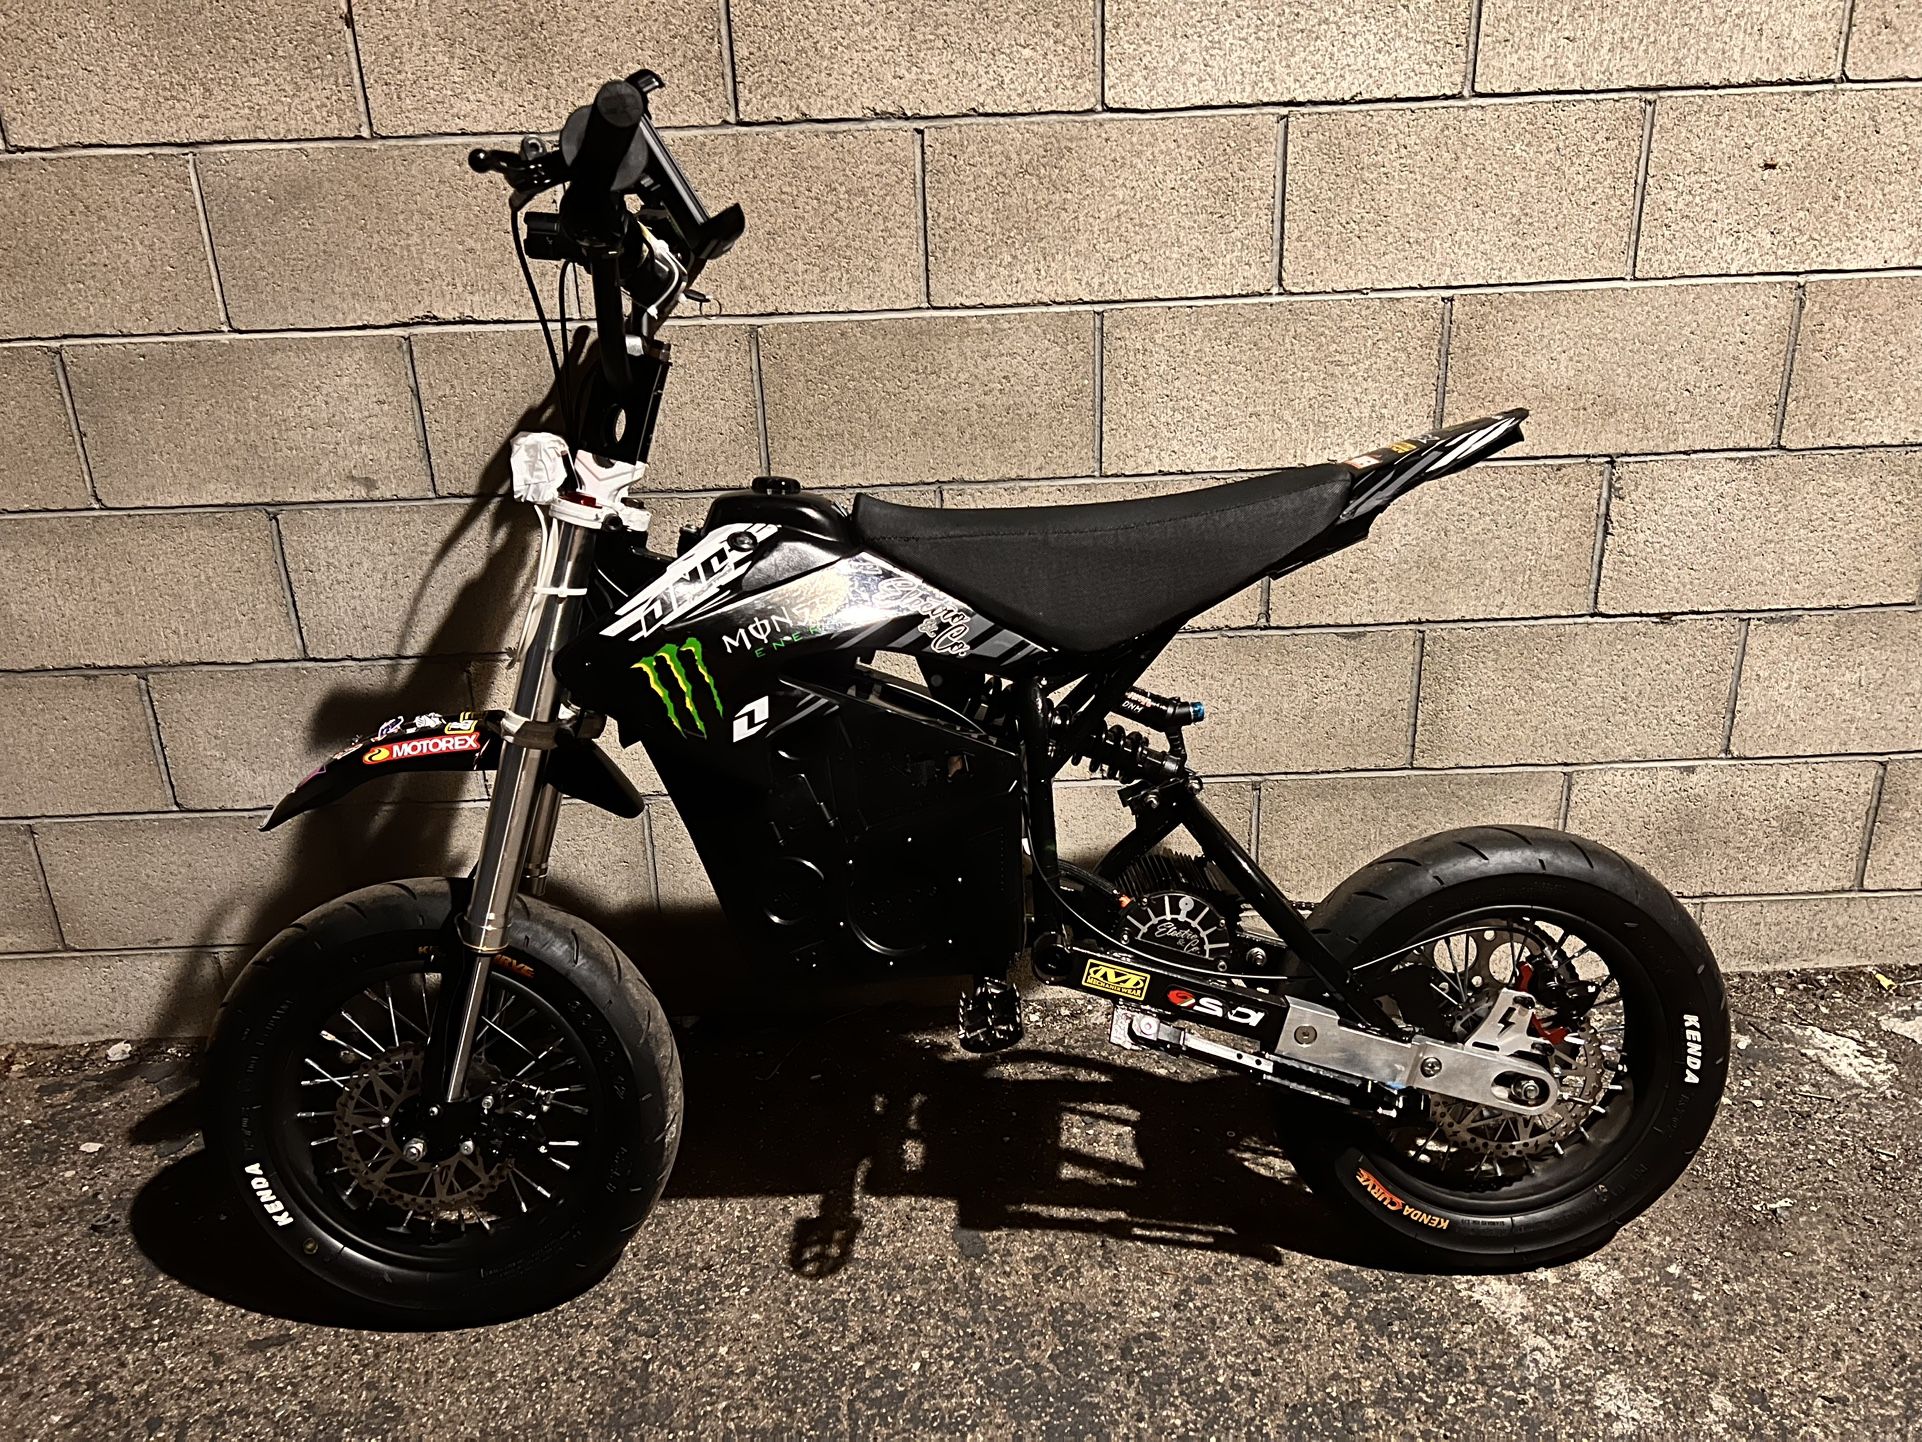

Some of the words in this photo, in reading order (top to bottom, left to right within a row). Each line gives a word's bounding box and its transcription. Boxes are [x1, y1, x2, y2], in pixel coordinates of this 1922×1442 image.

[392, 734, 480, 759] MOTOREX
[1154, 922, 1200, 941] Electro
[1121, 985, 1142, 998] WEAR
[1683, 1013, 1702, 1084] KENDA
[244, 1162, 294, 1227] KENDA
[1356, 1168, 1404, 1211] CURVE
[1402, 1205, 1450, 1230] KENDA
